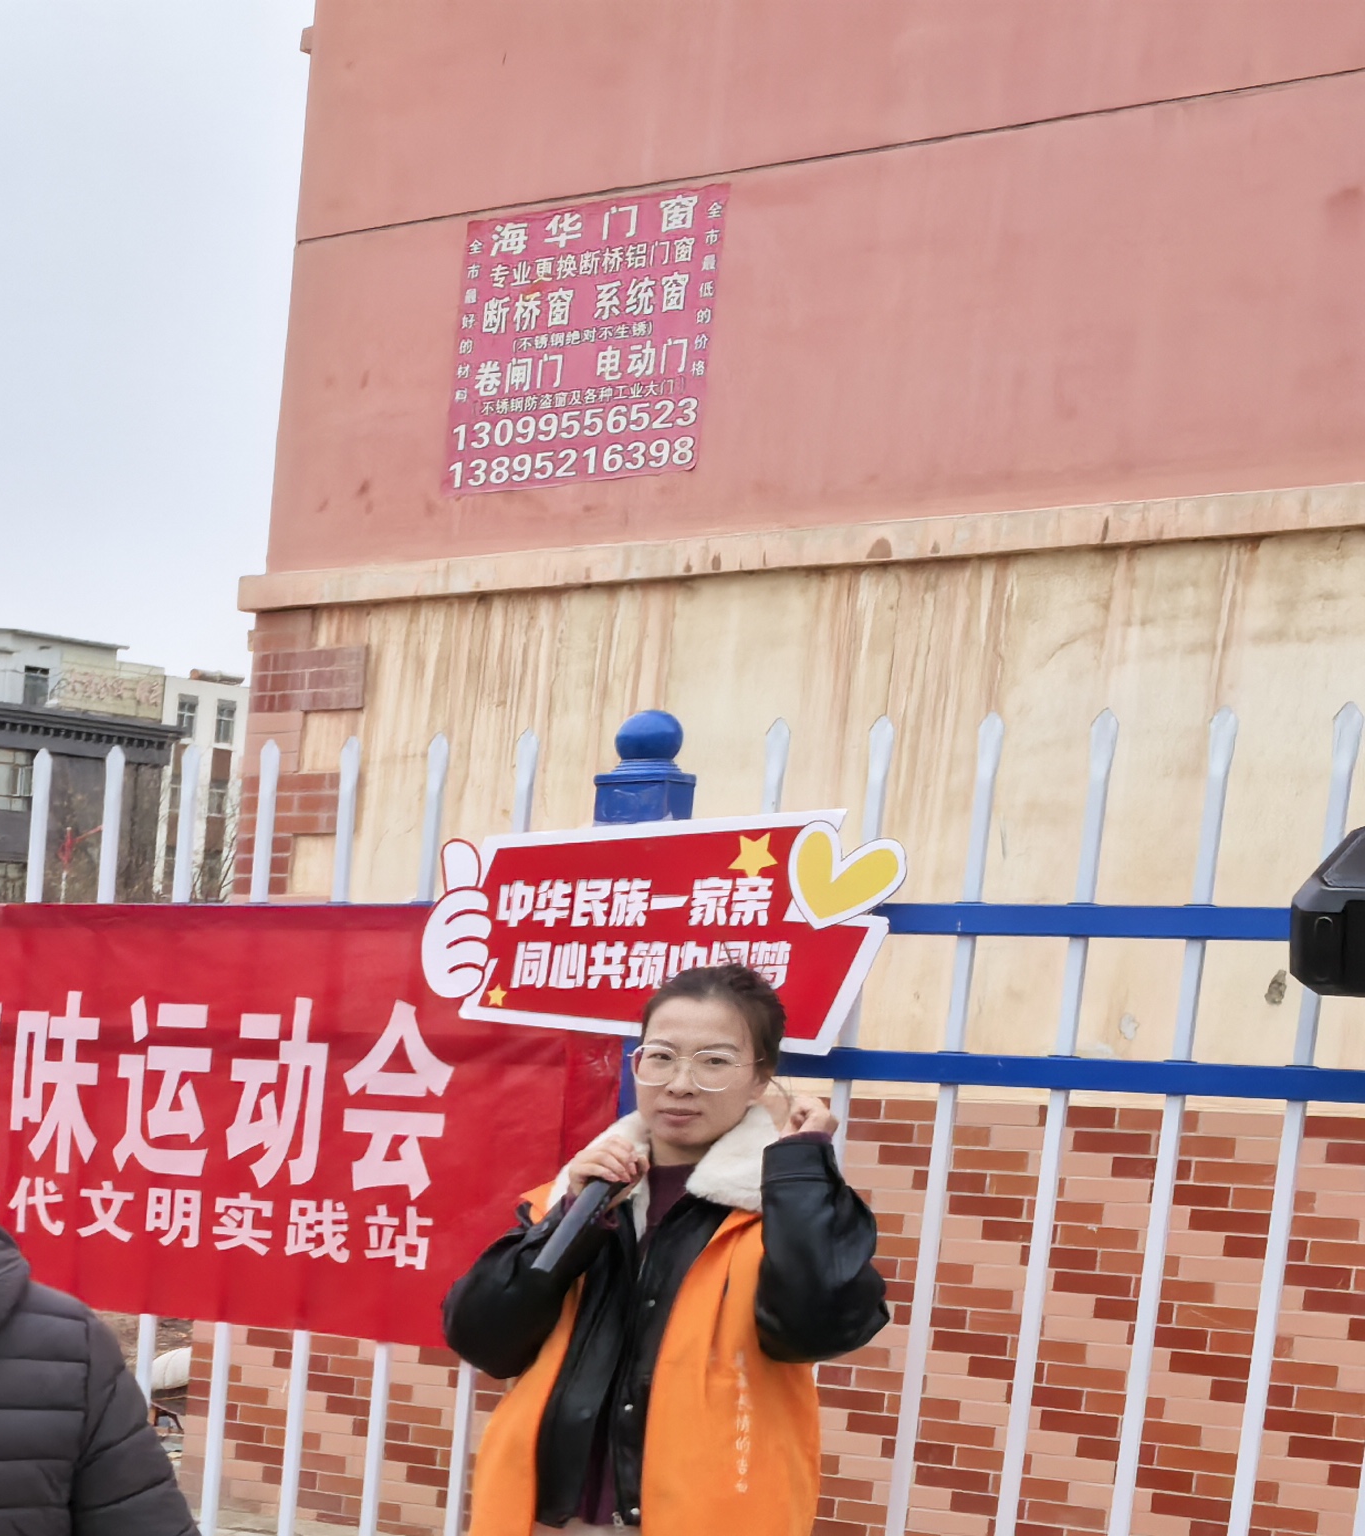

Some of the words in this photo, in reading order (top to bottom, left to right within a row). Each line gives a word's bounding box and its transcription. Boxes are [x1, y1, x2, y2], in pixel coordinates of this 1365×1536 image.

[490, 194, 698, 257] 海华门窗
[489, 236, 696, 289] 专业更换断桥铝门窗
[690, 202, 723, 378] 全市最低的价格
[481, 287, 575, 335] 断桥窗
[593, 271, 690, 321] 系统窗
[473, 353, 564, 397] 卷闸门
[595, 338, 688, 382] 电动门
[452, 396, 699, 451] 13099556523
[448, 436, 694, 489] 13895216398
[496, 876, 774, 929] 中华民族一家亲
